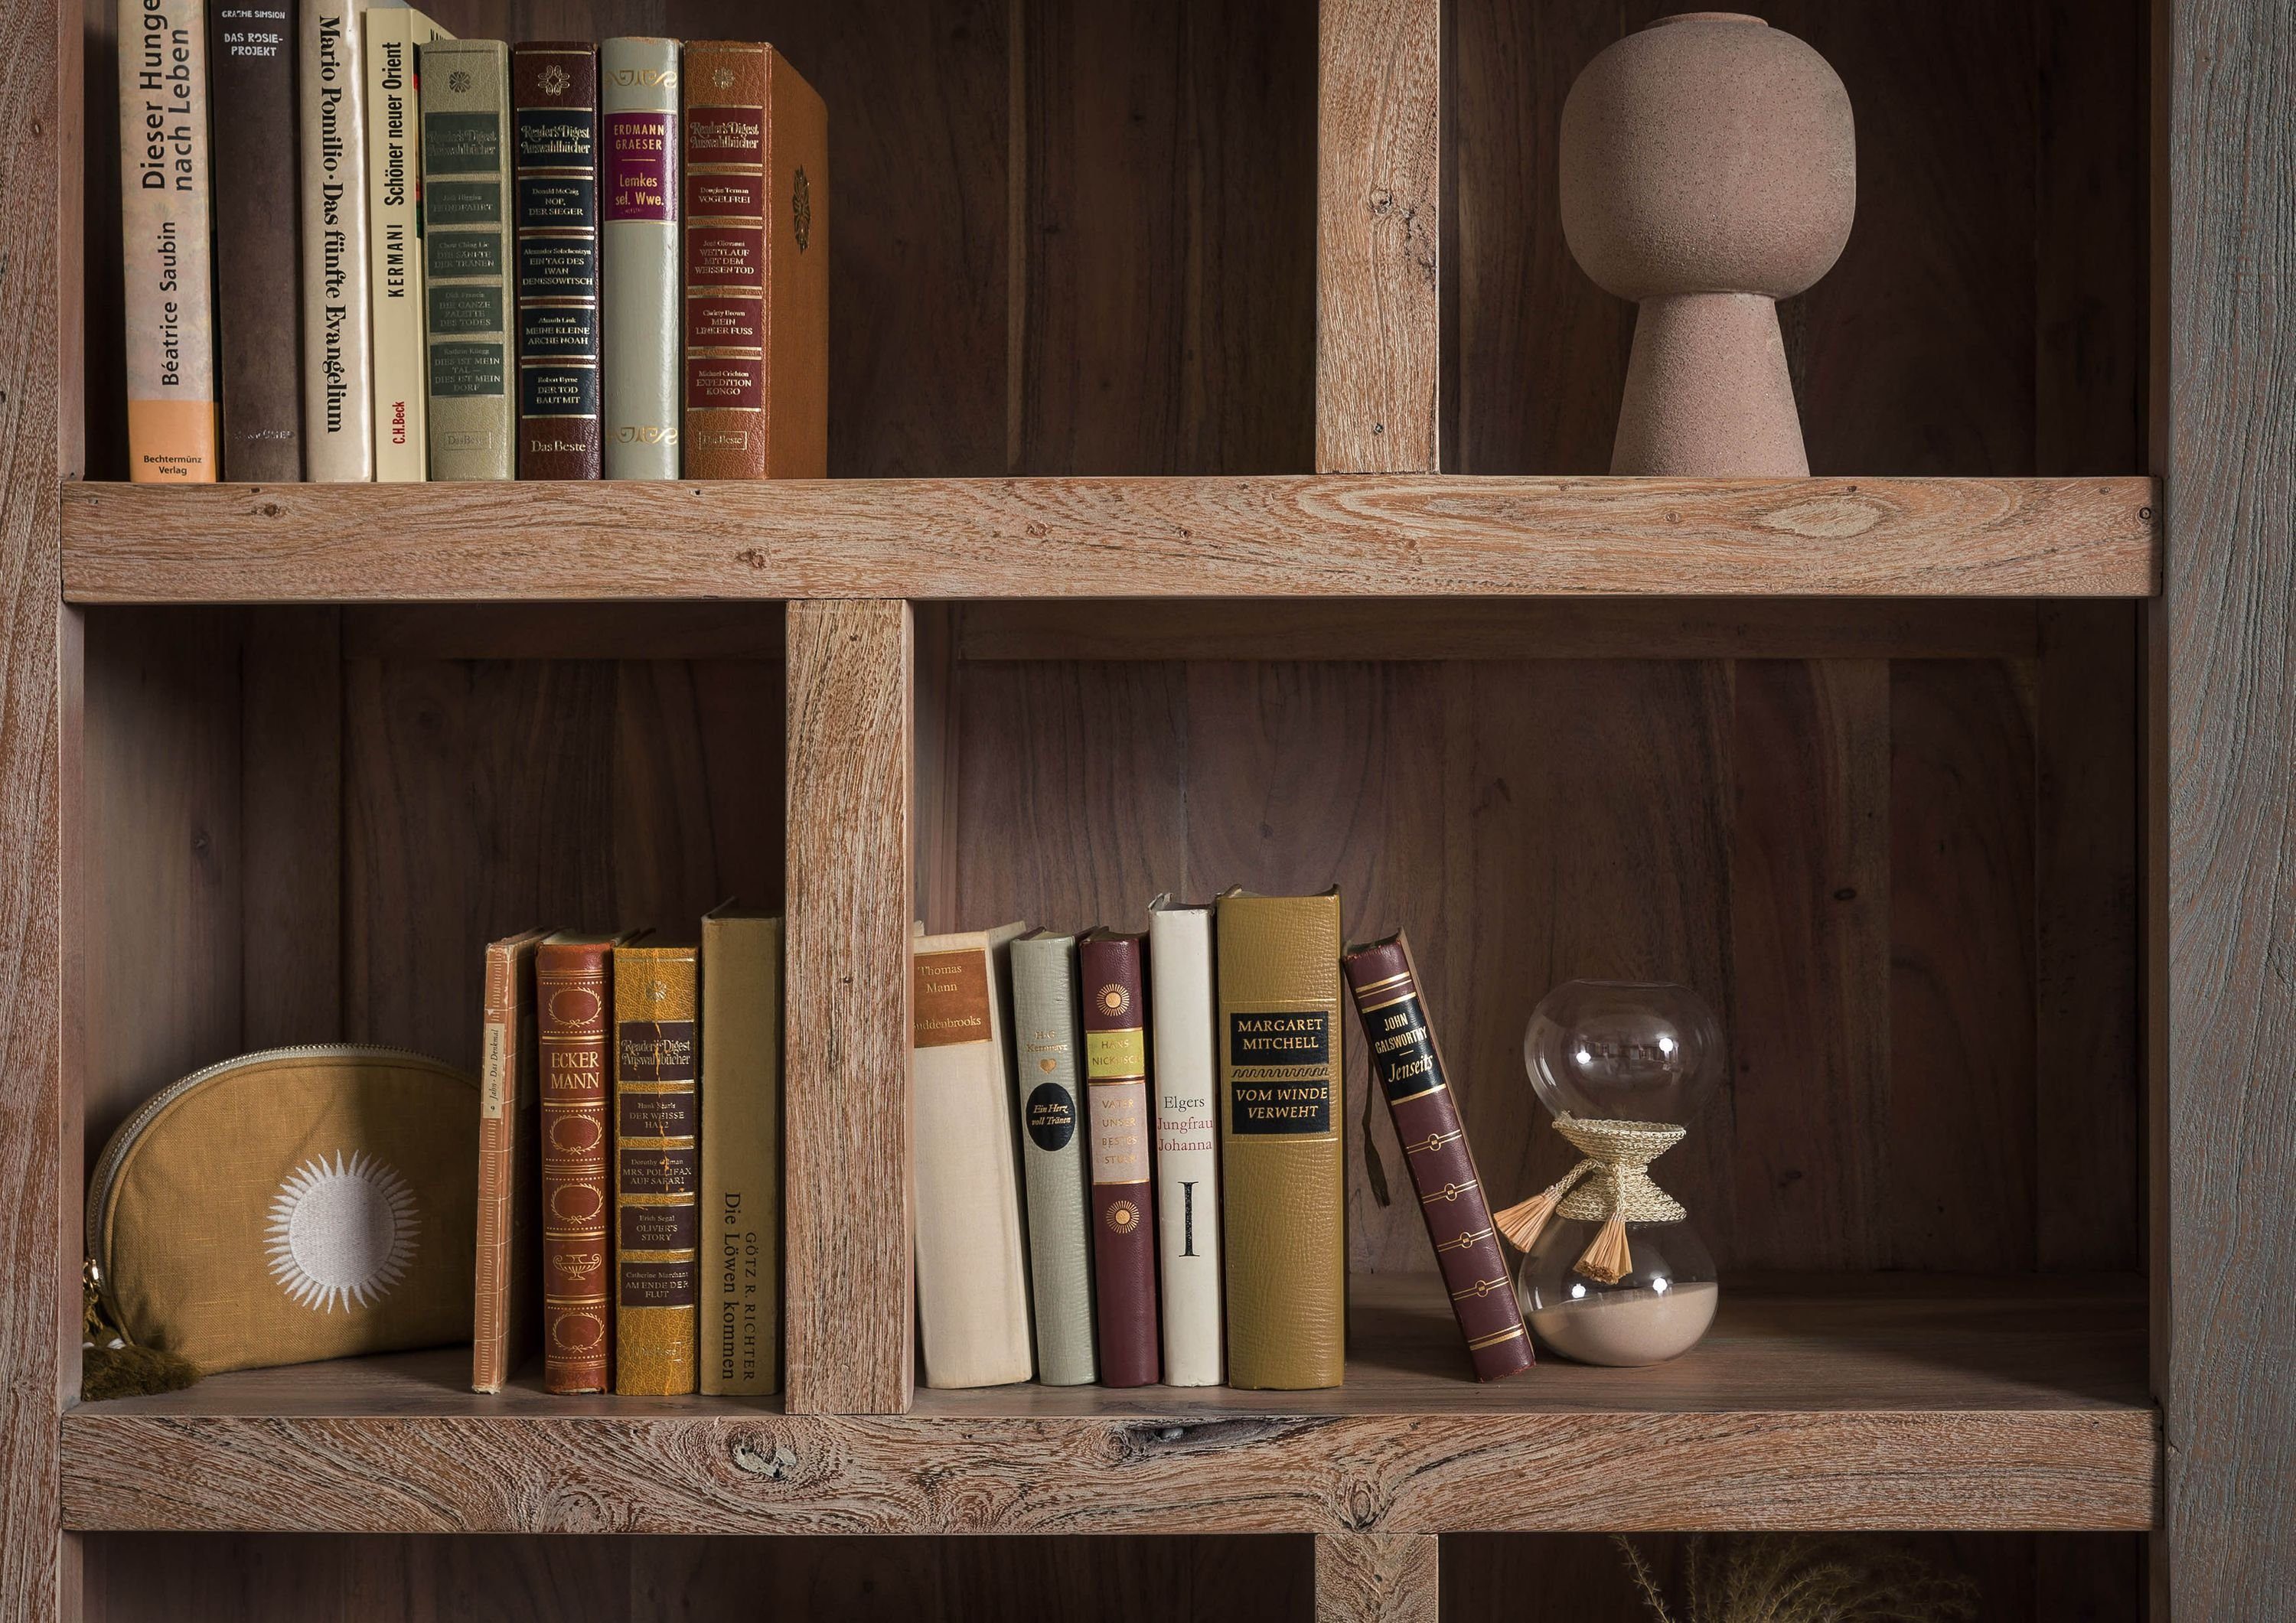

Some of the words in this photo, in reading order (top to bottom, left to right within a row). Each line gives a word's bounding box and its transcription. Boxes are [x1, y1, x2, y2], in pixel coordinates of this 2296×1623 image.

[221, 10, 253, 18] GRAEME
[254, 10, 285, 20] SIMSION
[224, 32, 244, 43] DAS
[247, 33, 284, 44] ROSIE-
[230, 45, 277, 57] PROJEKT
[319, 15, 341, 82] Mario
[165, 29, 191, 114] Leben
[382, 41, 403, 90] Orient
[387, 94, 403, 139] neuer
[321, 86, 344, 172] Pomilio
[558, 125, 590, 141] Digest
[614, 124, 664, 136] ERDMANN
[727, 122, 760, 139] Digest
[140, 101, 165, 189] Dieser
[521, 140, 591, 154] Auswahlbücher
[615, 139, 662, 151] GRAESER
[690, 135, 759, 149] Auswahlbücher
[167, 126, 192, 191] nach
[383, 142, 404, 206] Schöner
[620, 172, 657, 187] Lemkes
[321, 182, 344, 226] Das
[615, 191, 631, 206] sel.
[634, 191, 664, 206] Wwe.
[549, 207, 584, 216] SIEGER
[158, 221, 178, 292] Saubin
[324, 229, 347, 299] fünfte
[386, 224, 405, 298] KERMANI
[734, 266, 755, 275] TOD
[522, 277, 593, 285] DENISSOWITSCH
[526, 327, 554, 335] MEINE
[556, 327, 591, 335] KLEINE
[730, 327, 753, 335] FUSS
[159, 301, 179, 386] Béatrice
[560, 337, 589, 345] NOAH
[321, 304, 347, 435] Evangelium
[696, 379, 752, 387] EXPEDITION
[706, 387, 741, 396] KONGO
[392, 401, 406, 445] C.H.Beck
[531, 440, 553, 452] Das
[553, 440, 586, 452] Beste
[143, 455, 202, 464] Bechtermünz
[158, 465, 188, 476] Verlag
[918, 965, 962, 976] Thomas
[926, 983, 958, 994] Mann
[1238, 1018, 1323, 1032] MARGARET
[1384, 1012, 1409, 1031] JOHN
[490, 1029, 499, 1061] Denkmal
[660, 1039, 690, 1054] Digest
[1101, 1039, 1129, 1049] HANS
[1242, 1036, 1319, 1050] MITCHELL
[1375, 1025, 1428, 1054] GALSWORTHY
[550, 1051, 599, 1069] ECKER
[490, 1064, 498, 1077] Das
[1388, 1054, 1433, 1083] Jenseits
[550, 1072, 600, 1090] MANN
[1236, 1089, 1273, 1101] VOM
[1277, 1087, 1328, 1100] WINDE
[1033, 1104, 1048, 1114] Ein
[1049, 1103, 1069, 1114] Herz
[1101, 1098, 1133, 1109] VATER
[1164, 1096, 1205, 1112] Elgers
[651, 1111, 685, 1119] WEISSE
[1247, 1106, 1319, 1119] VERWEHT
[1032, 1116, 1045, 1126] voll
[1047, 1116, 1071, 1126] Tränen
[1102, 1116, 1136, 1128] UNSER
[1157, 1116, 1213, 1134] Jungfrau
[1158, 1138, 1212, 1152] Johanna
[724, 1192, 741, 1225] Die
[1177, 1181, 1201, 1258] I
[745, 1232, 759, 1278] GÖTZ
[723, 1234, 741, 1293] Löwen
[745, 1285, 756, 1299] R.
[722, 1301, 740, 1380] kommen
[743, 1304, 756, 1380] RICHTER
